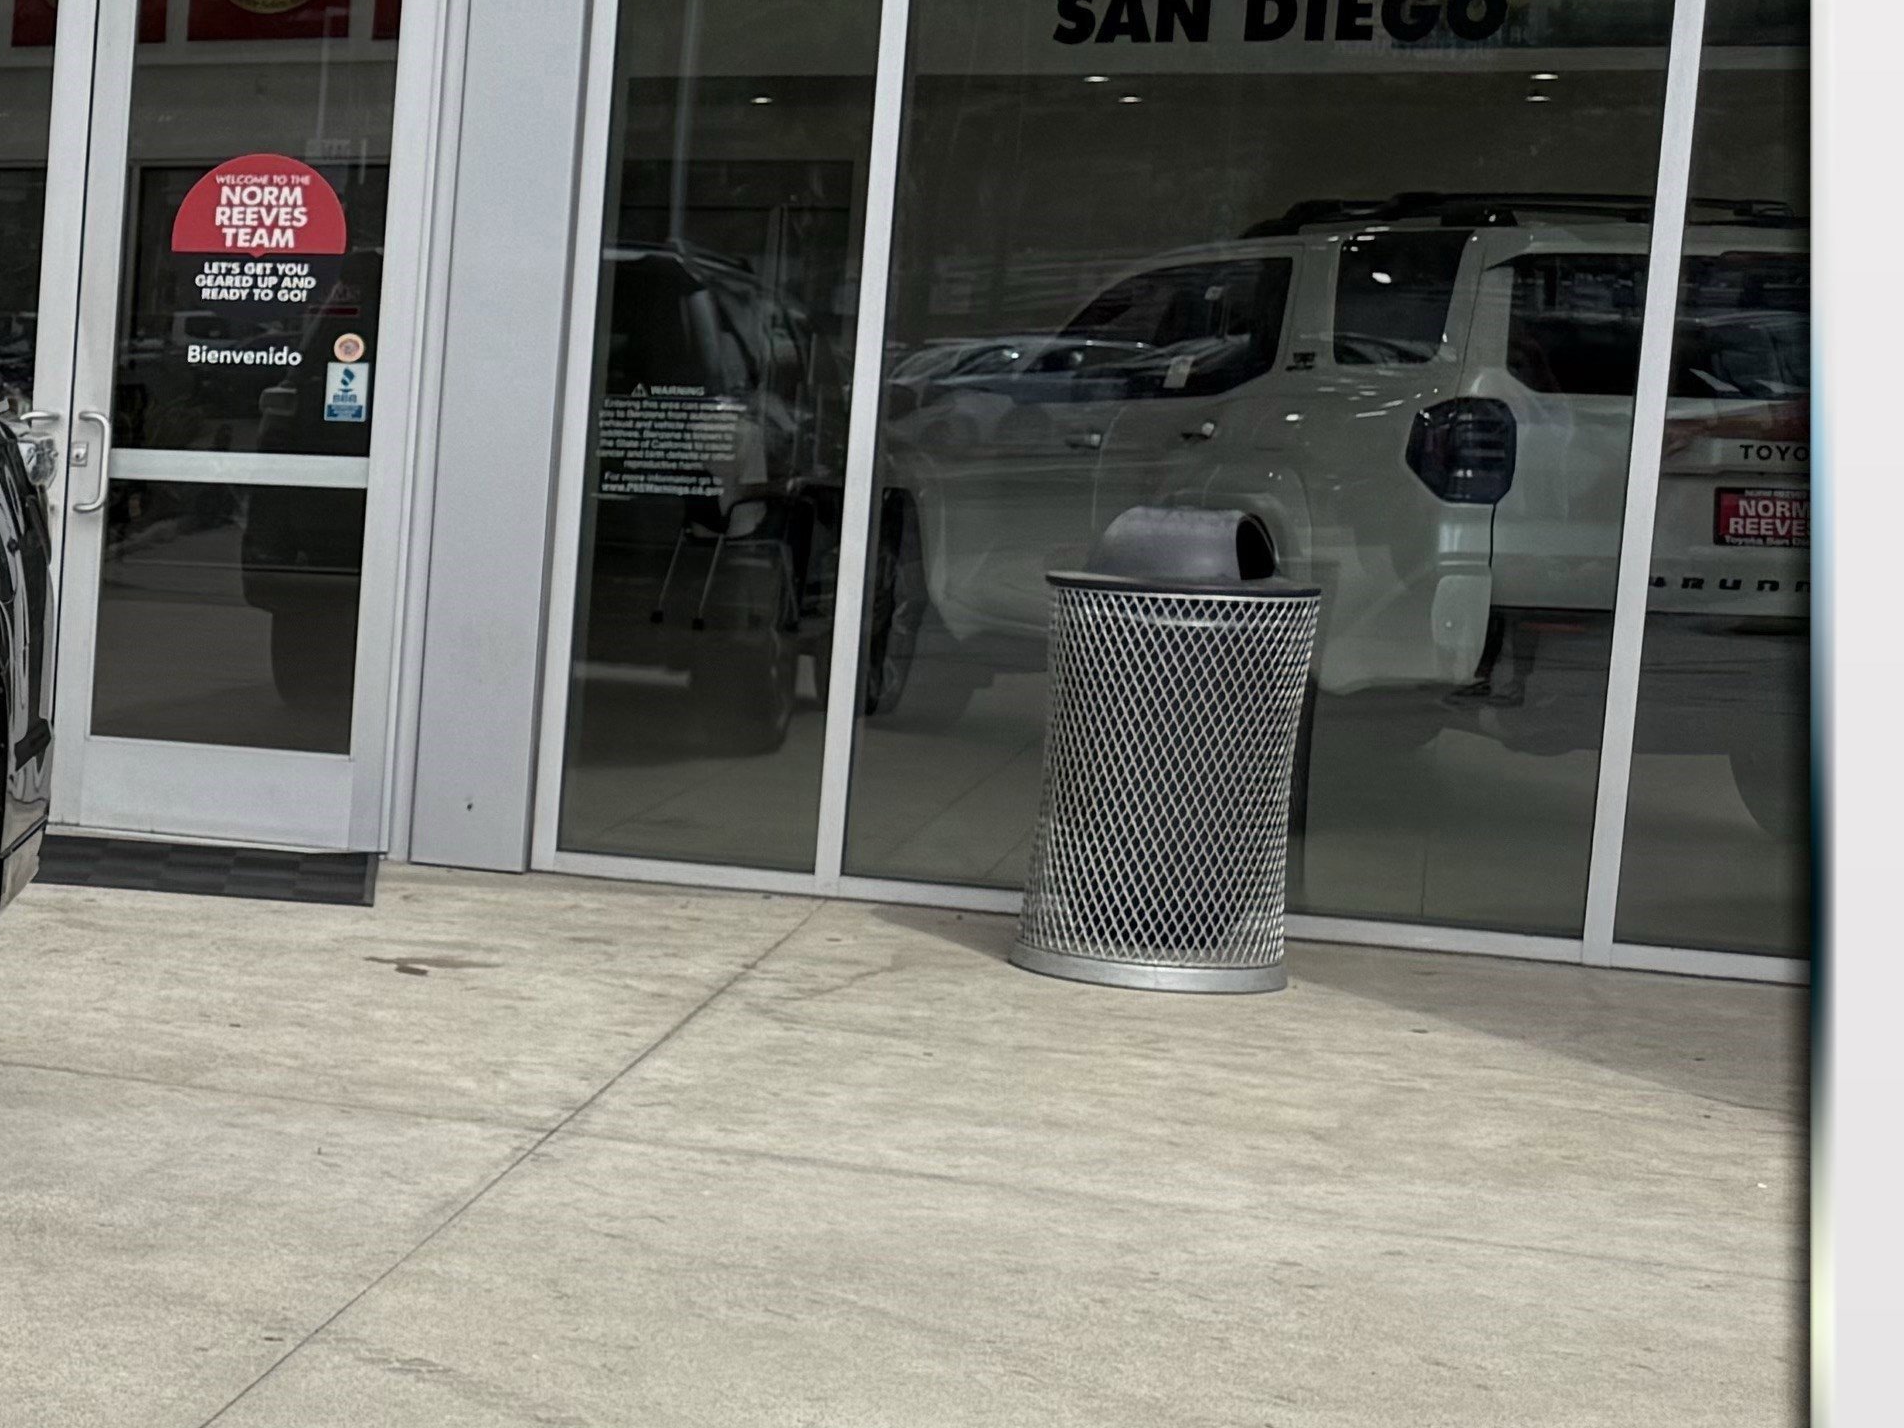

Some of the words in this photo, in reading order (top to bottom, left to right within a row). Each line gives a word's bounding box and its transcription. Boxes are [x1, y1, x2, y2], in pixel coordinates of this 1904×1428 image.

[215, 174, 269, 186] WELCOME
[272, 174, 288, 186] TO
[290, 174, 311, 186] THE
[220, 186, 302, 206] NORM
[215, 206, 308, 227] REEVES
[222, 228, 295, 249] TEAM
[203, 261, 241, 275] LET'S
[244, 262, 274, 275] GET
[277, 262, 309, 276] YOU
[195, 274, 253, 288] GEARED
[257, 275, 278, 288] UP
[281, 276, 316, 289] AND
[202, 287, 250, 301] READY
[252, 288, 273, 301] TO
[277, 289, 308, 302] GO!
[187, 344, 302, 366] Bienvenido
[1739, 444, 1810, 461] TOYO
[1738, 498, 1810, 518] NORM
[1729, 517, 1810, 537] REEVE
